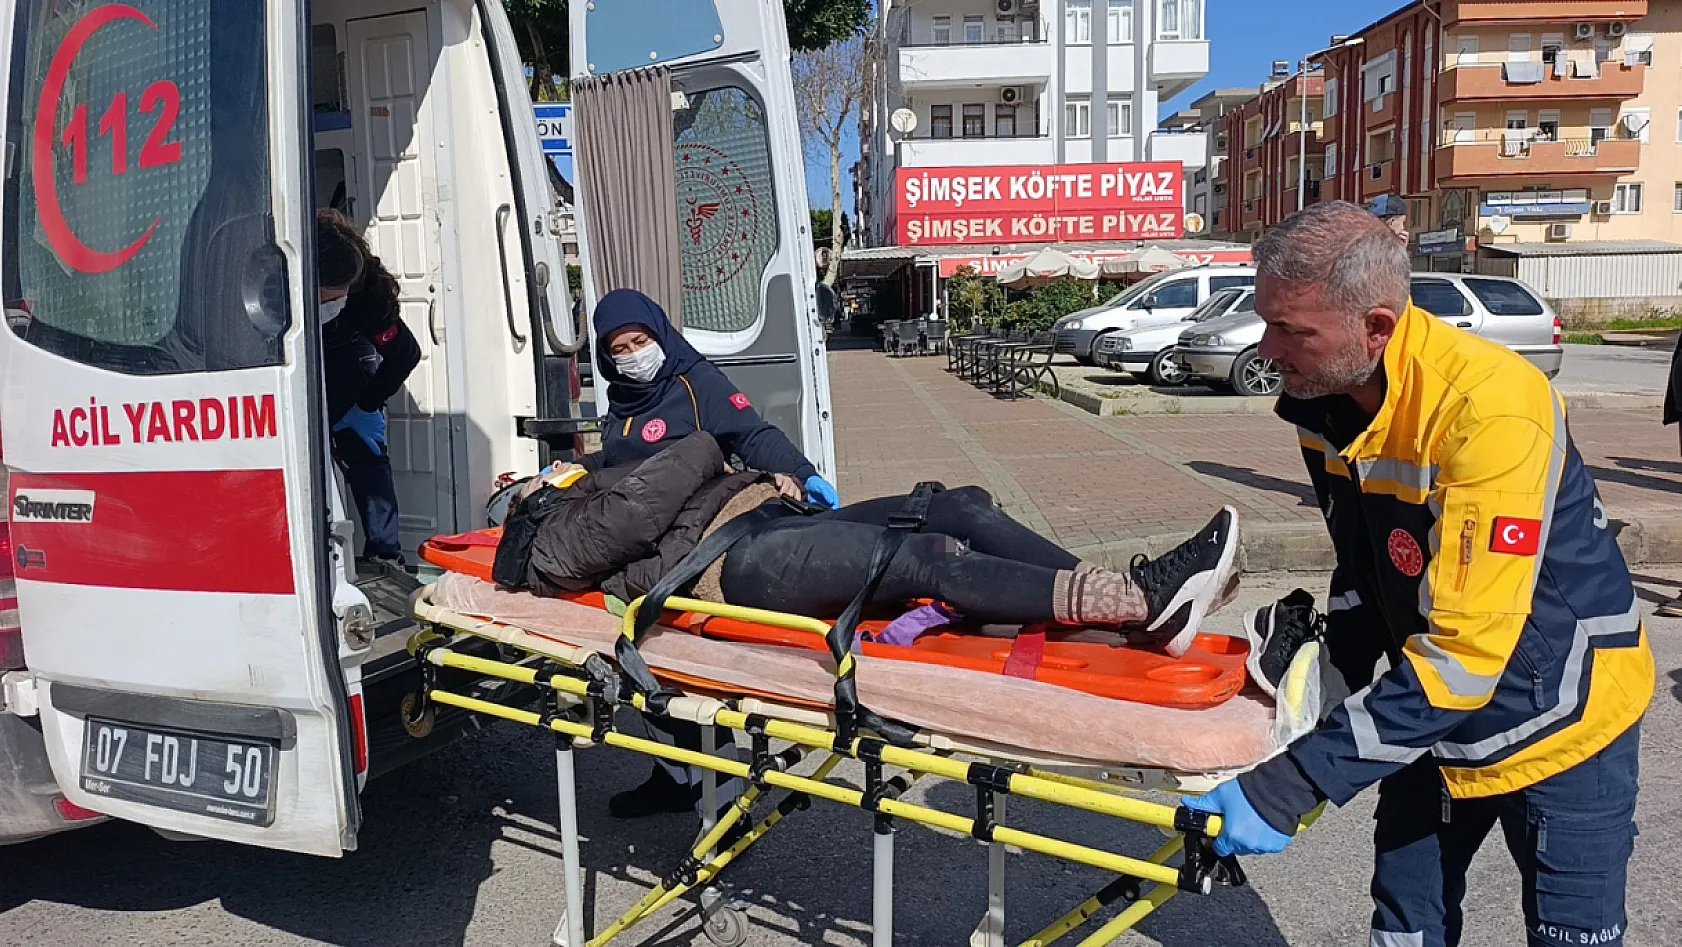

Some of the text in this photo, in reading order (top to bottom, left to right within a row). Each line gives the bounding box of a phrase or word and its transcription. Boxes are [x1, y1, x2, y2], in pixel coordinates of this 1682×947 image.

[62, 80, 182, 185] 112
[905, 167, 1174, 208] ŞİMŞEK KÖFTE PİYAZ
[907, 210, 1175, 243] ŞİMŞEK KÖFTE PİYAZ
[51, 394, 278, 447] ACİL YARDIM
[14, 495, 92, 521] SPRINTER
[96, 727, 262, 798] 07 FDJ 50
